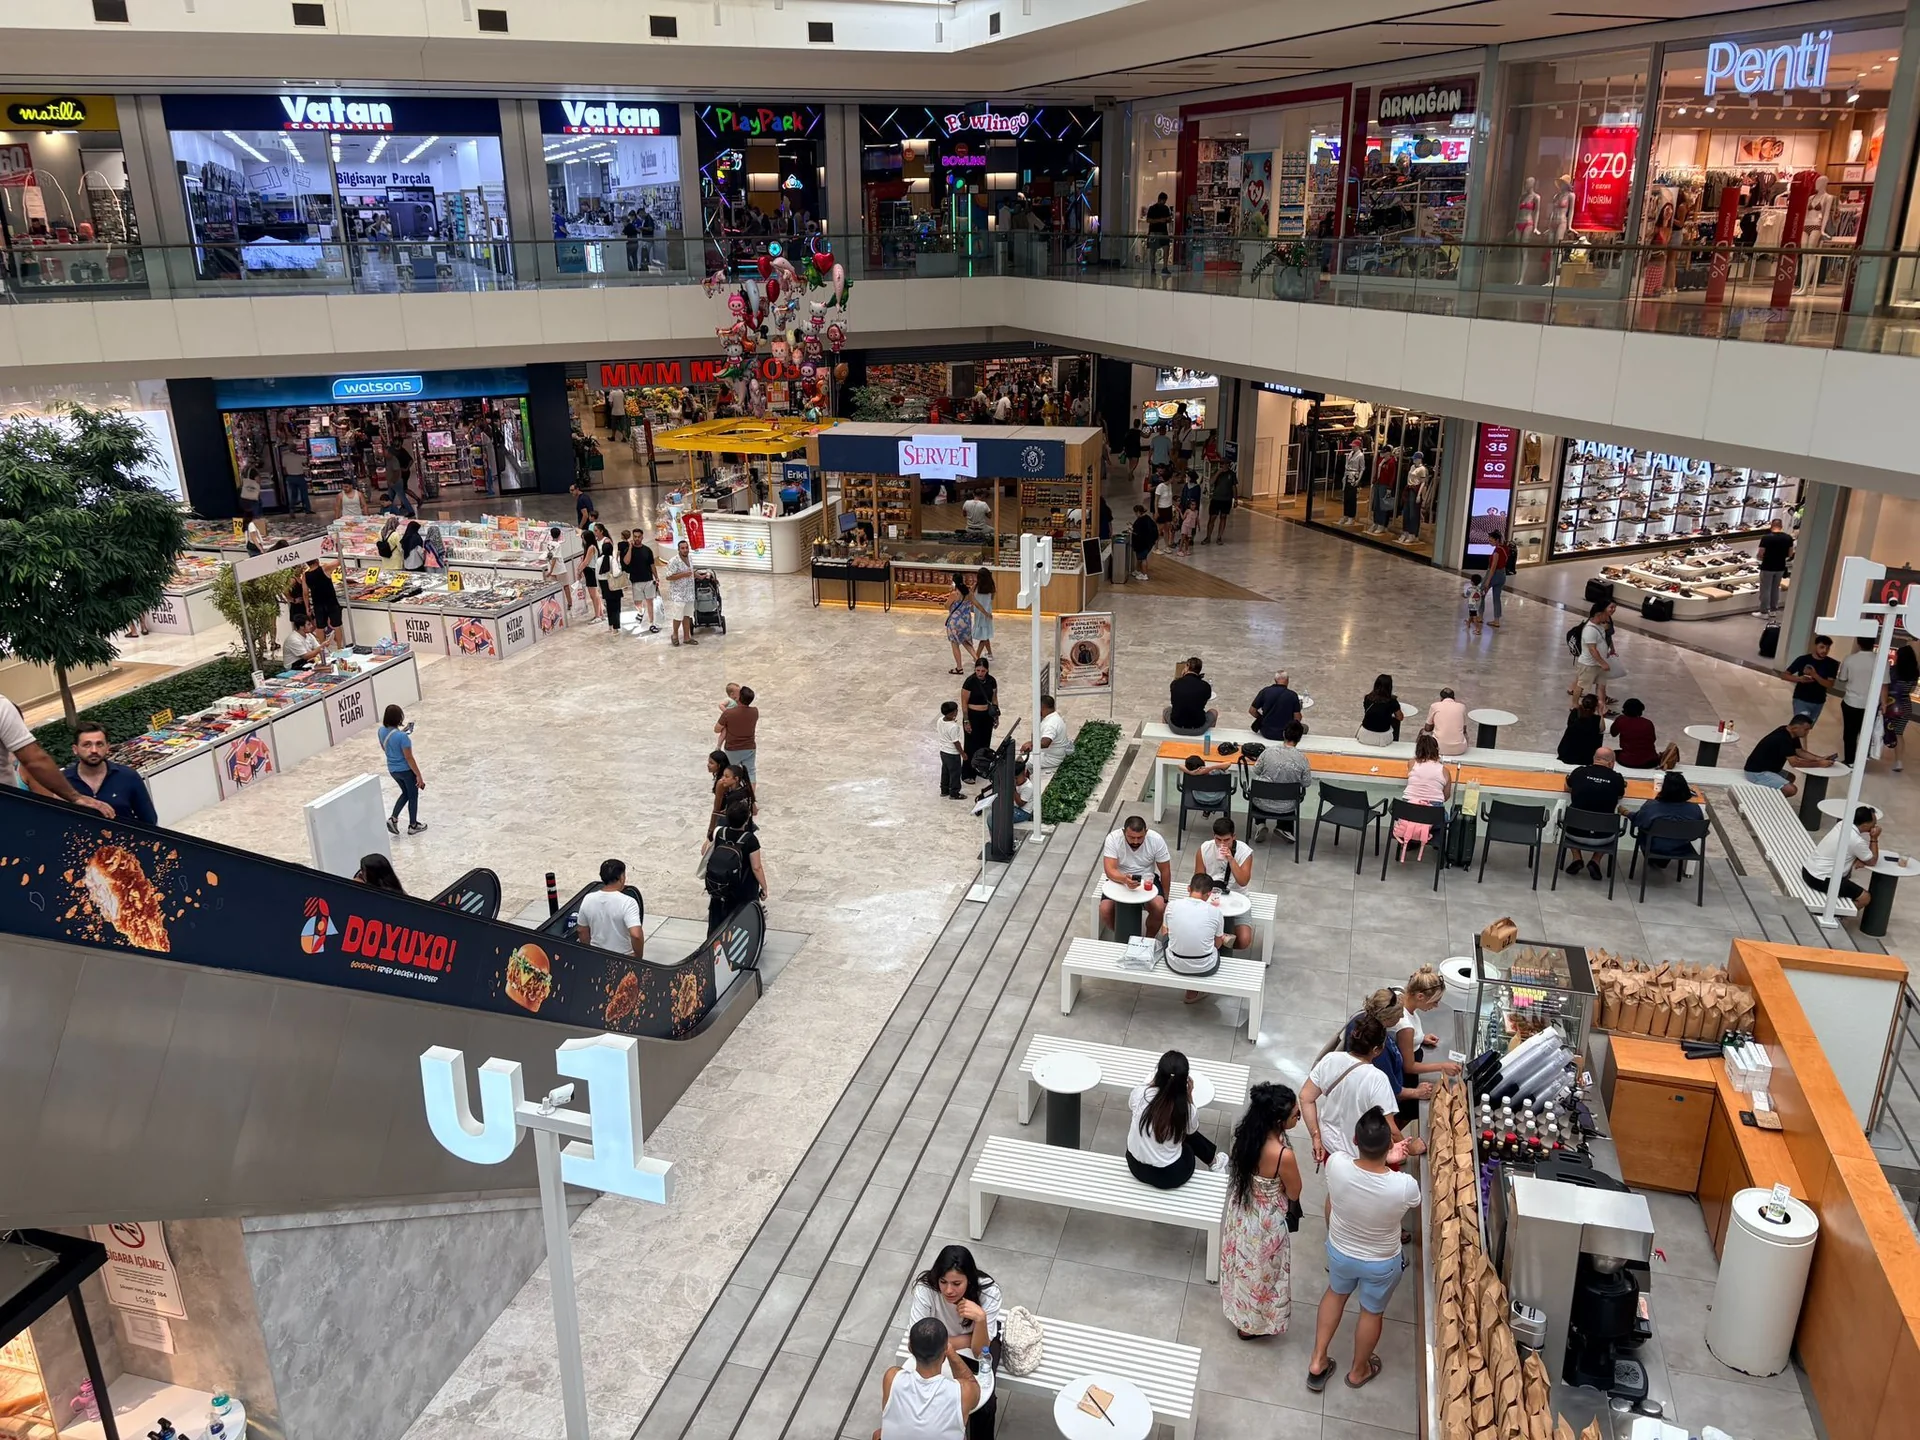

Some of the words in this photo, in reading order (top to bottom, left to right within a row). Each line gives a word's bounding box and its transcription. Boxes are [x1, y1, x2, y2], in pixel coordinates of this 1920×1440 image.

[1704, 30, 1833, 96] Penti
[19, 101, 85, 121] matilla
[279, 96, 393, 123] Vatan
[1380, 85, 1462, 119] ARMAĞAN
[561, 101, 660, 127] Vatan
[290, 123, 386, 131] COMPUTER
[942, 155, 986, 166] BOWLING
[1582, 151, 1627, 179] %70
[337, 172, 388, 187] Bilgisayar
[392, 172, 431, 187] Parçala
[601, 361, 681, 388] MMM
[343, 381, 412, 394] watsons
[903, 444, 971, 468] SERVET
[276, 551, 301, 566] KASA
[449, 574, 458, 582] 30
[151, 612, 178, 625] FUARI
[405, 617, 431, 632] KİTAP
[506, 615, 523, 632] KİTAP
[407, 631, 433, 644] FUARI
[507, 627, 525, 645] FUARI
[338, 691, 361, 713] KİTAP
[340, 704, 364, 728] FUARI
[341, 914, 457, 973] DOYUYO!
[134, 1253, 167, 1272] İÇİLMEZ
